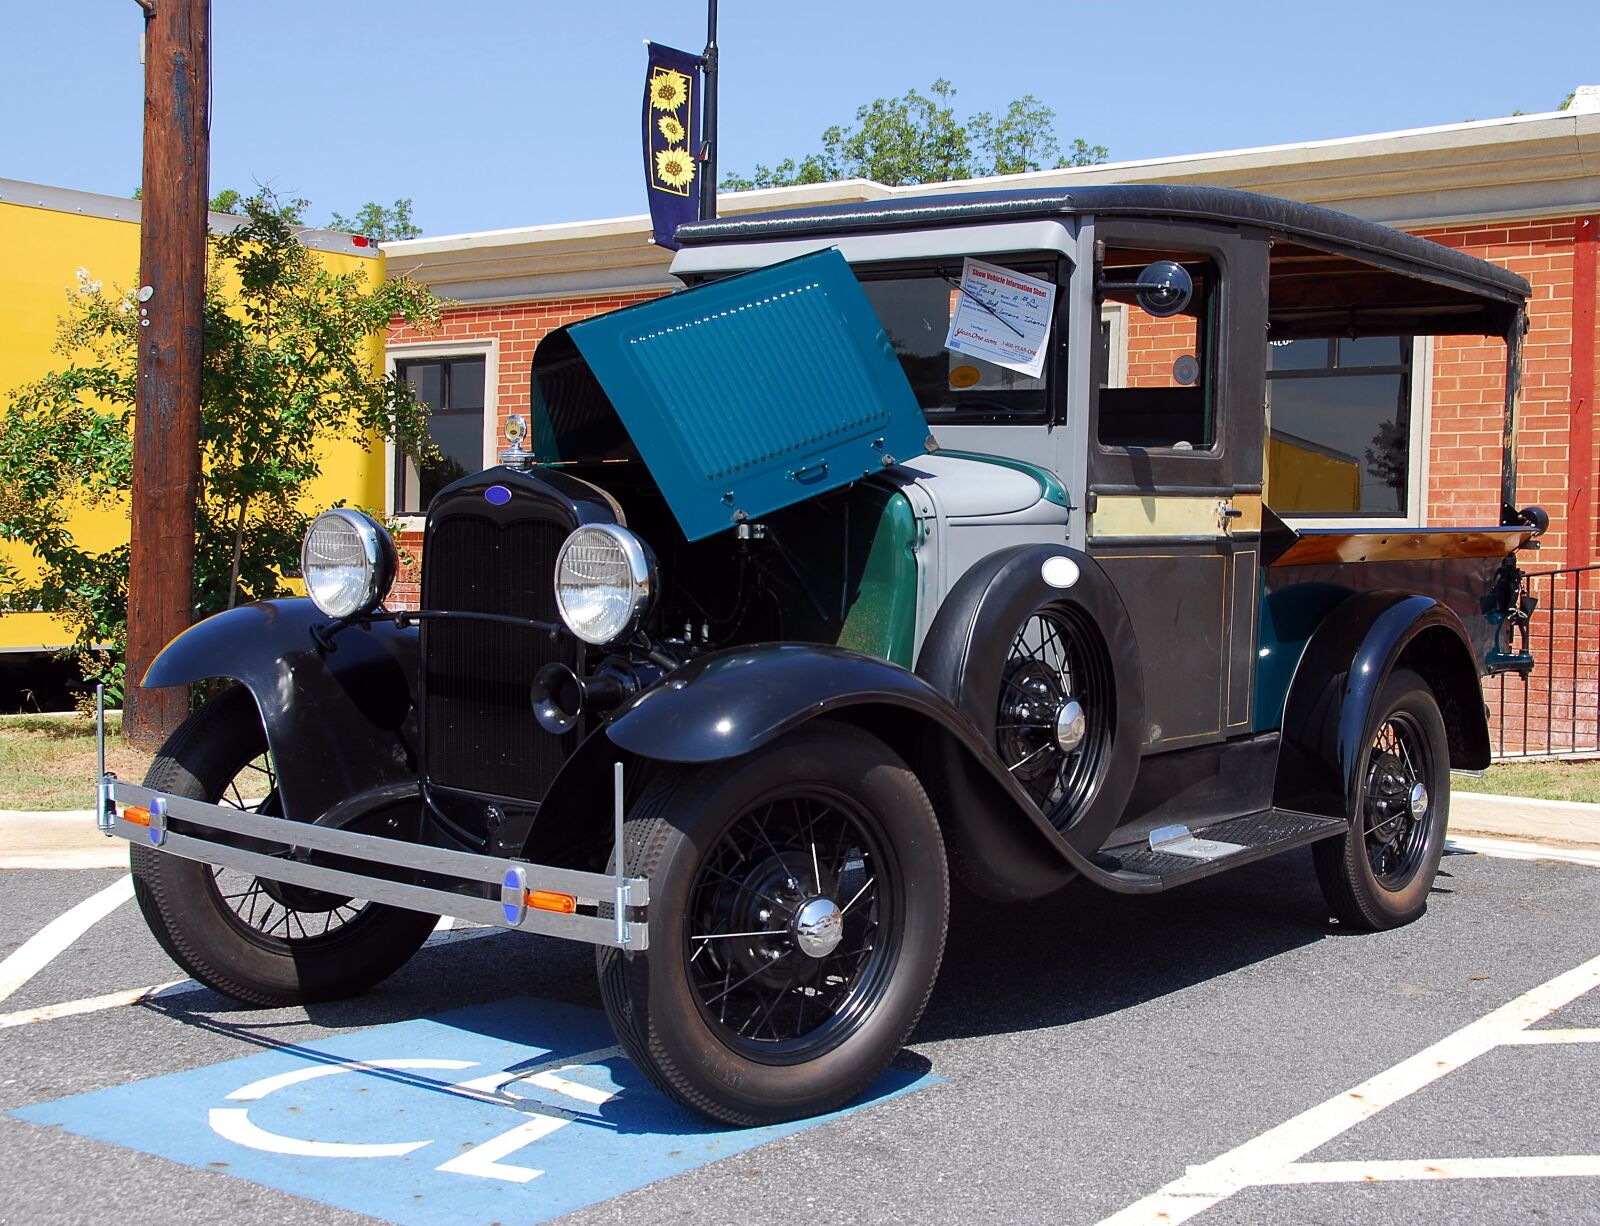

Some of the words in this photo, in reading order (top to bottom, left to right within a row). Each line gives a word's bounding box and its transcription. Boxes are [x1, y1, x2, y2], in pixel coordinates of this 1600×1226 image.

[972, 269, 987, 279] Show
[987, 272, 1005, 284] Vehicle
[1006, 278, 1033, 293] Information
[1033, 288, 1047, 298] Sheet
[954, 327, 998, 346] YearOne.com
